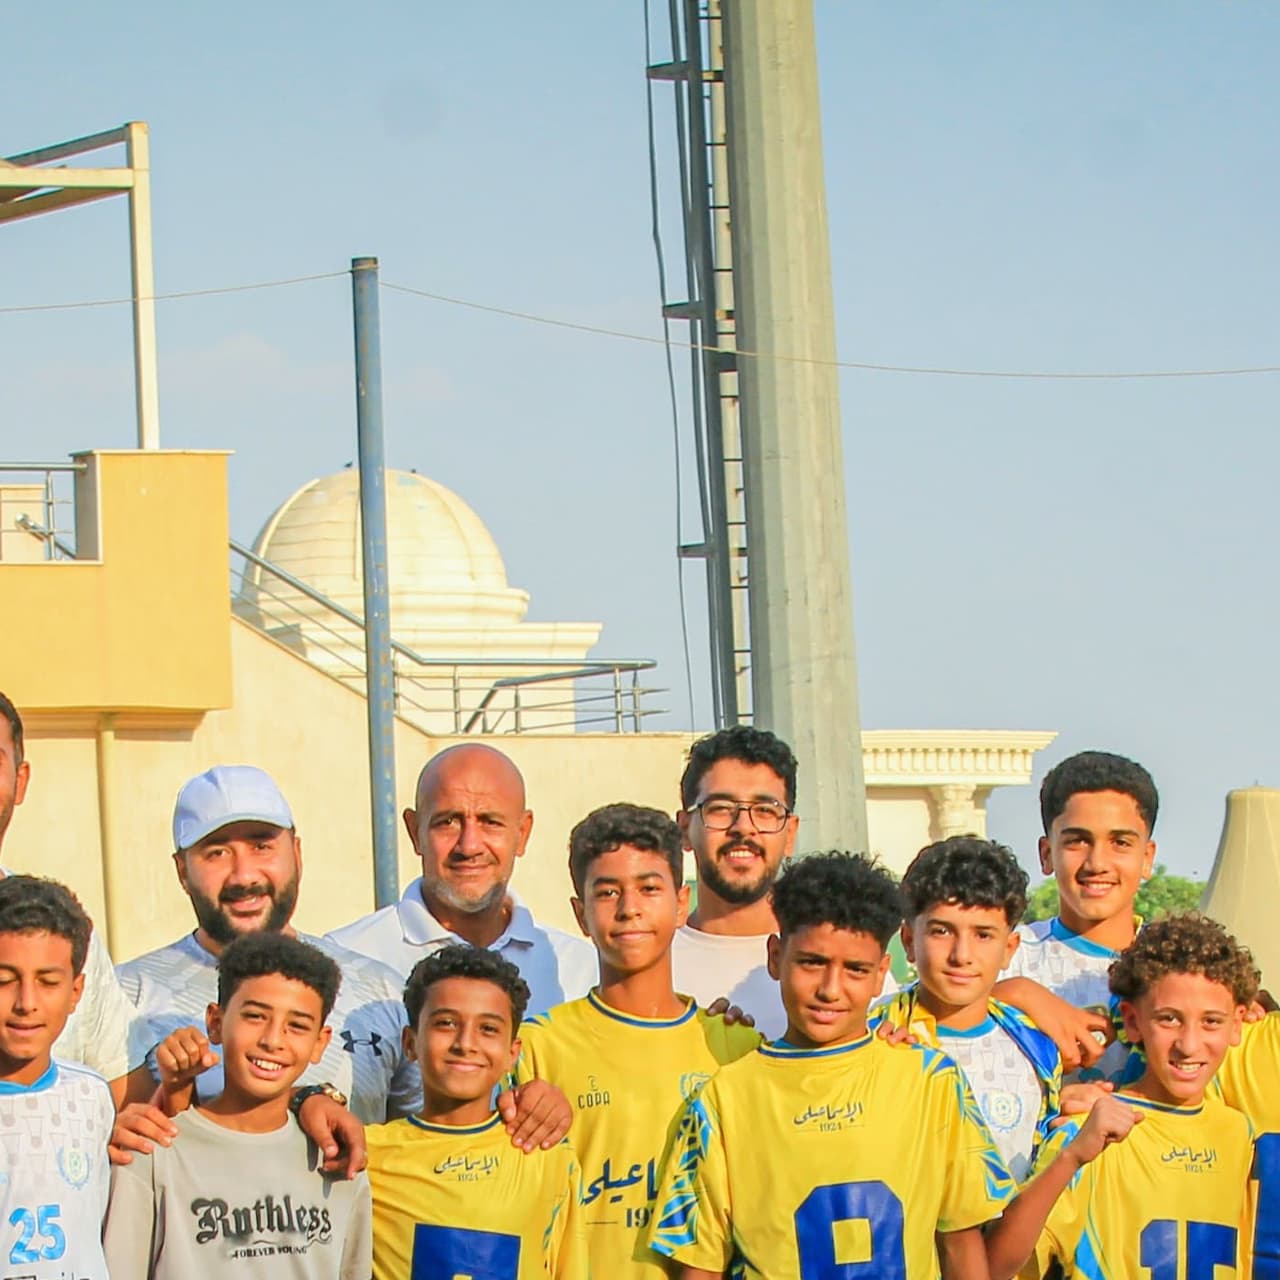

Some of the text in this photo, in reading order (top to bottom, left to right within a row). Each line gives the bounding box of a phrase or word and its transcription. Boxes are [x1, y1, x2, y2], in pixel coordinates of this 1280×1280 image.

[577, 1091, 611, 1110] COPA
[190, 1194, 333, 1245] Ruthless
[626, 1207, 654, 1229] 19
[9, 1204, 66, 1264] 25
[231, 1244, 308, 1259] FOREVER YOUNG
